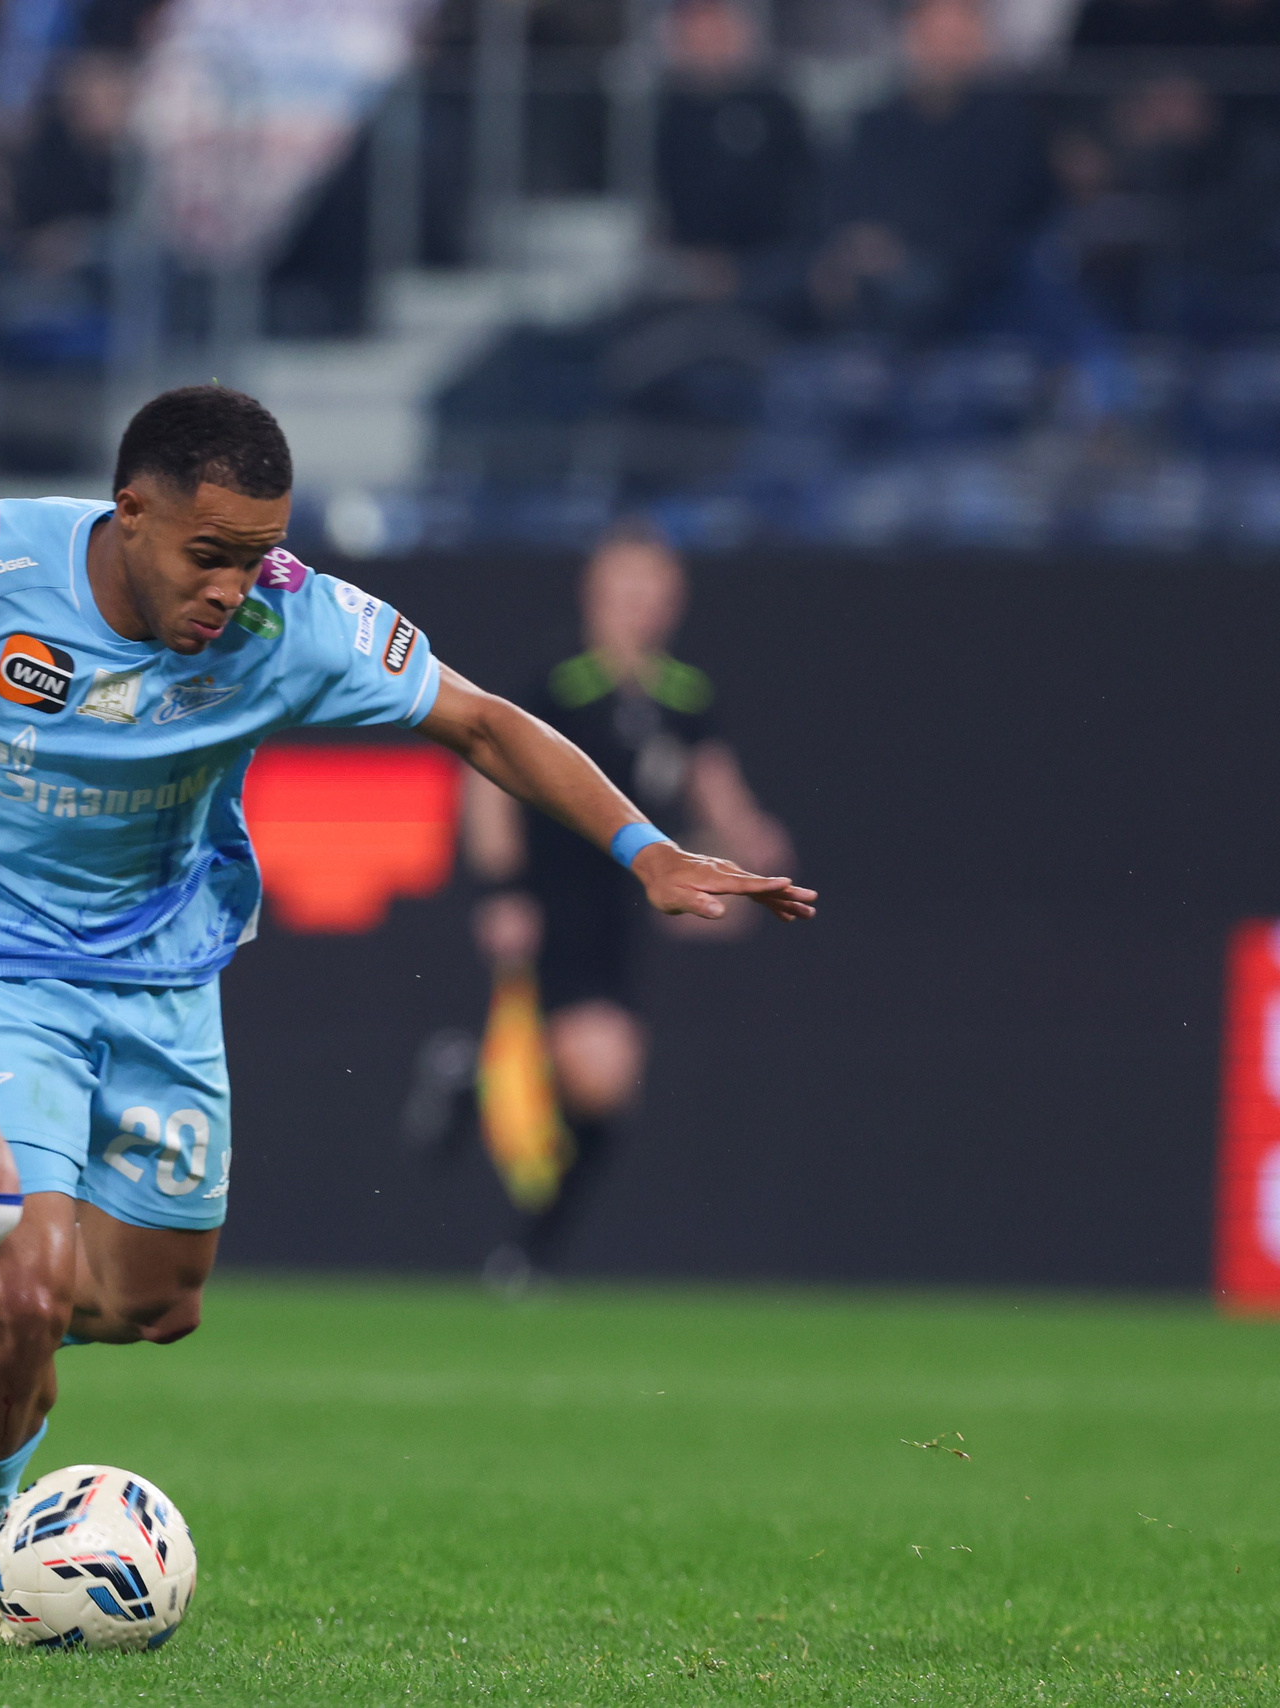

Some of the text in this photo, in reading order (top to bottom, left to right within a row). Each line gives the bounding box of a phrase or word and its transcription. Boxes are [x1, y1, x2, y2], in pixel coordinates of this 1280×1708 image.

[13, 661, 66, 696] WIN
[36, 764, 209, 818] ГАЗПРОМ
[102, 1106, 210, 1196] 20
